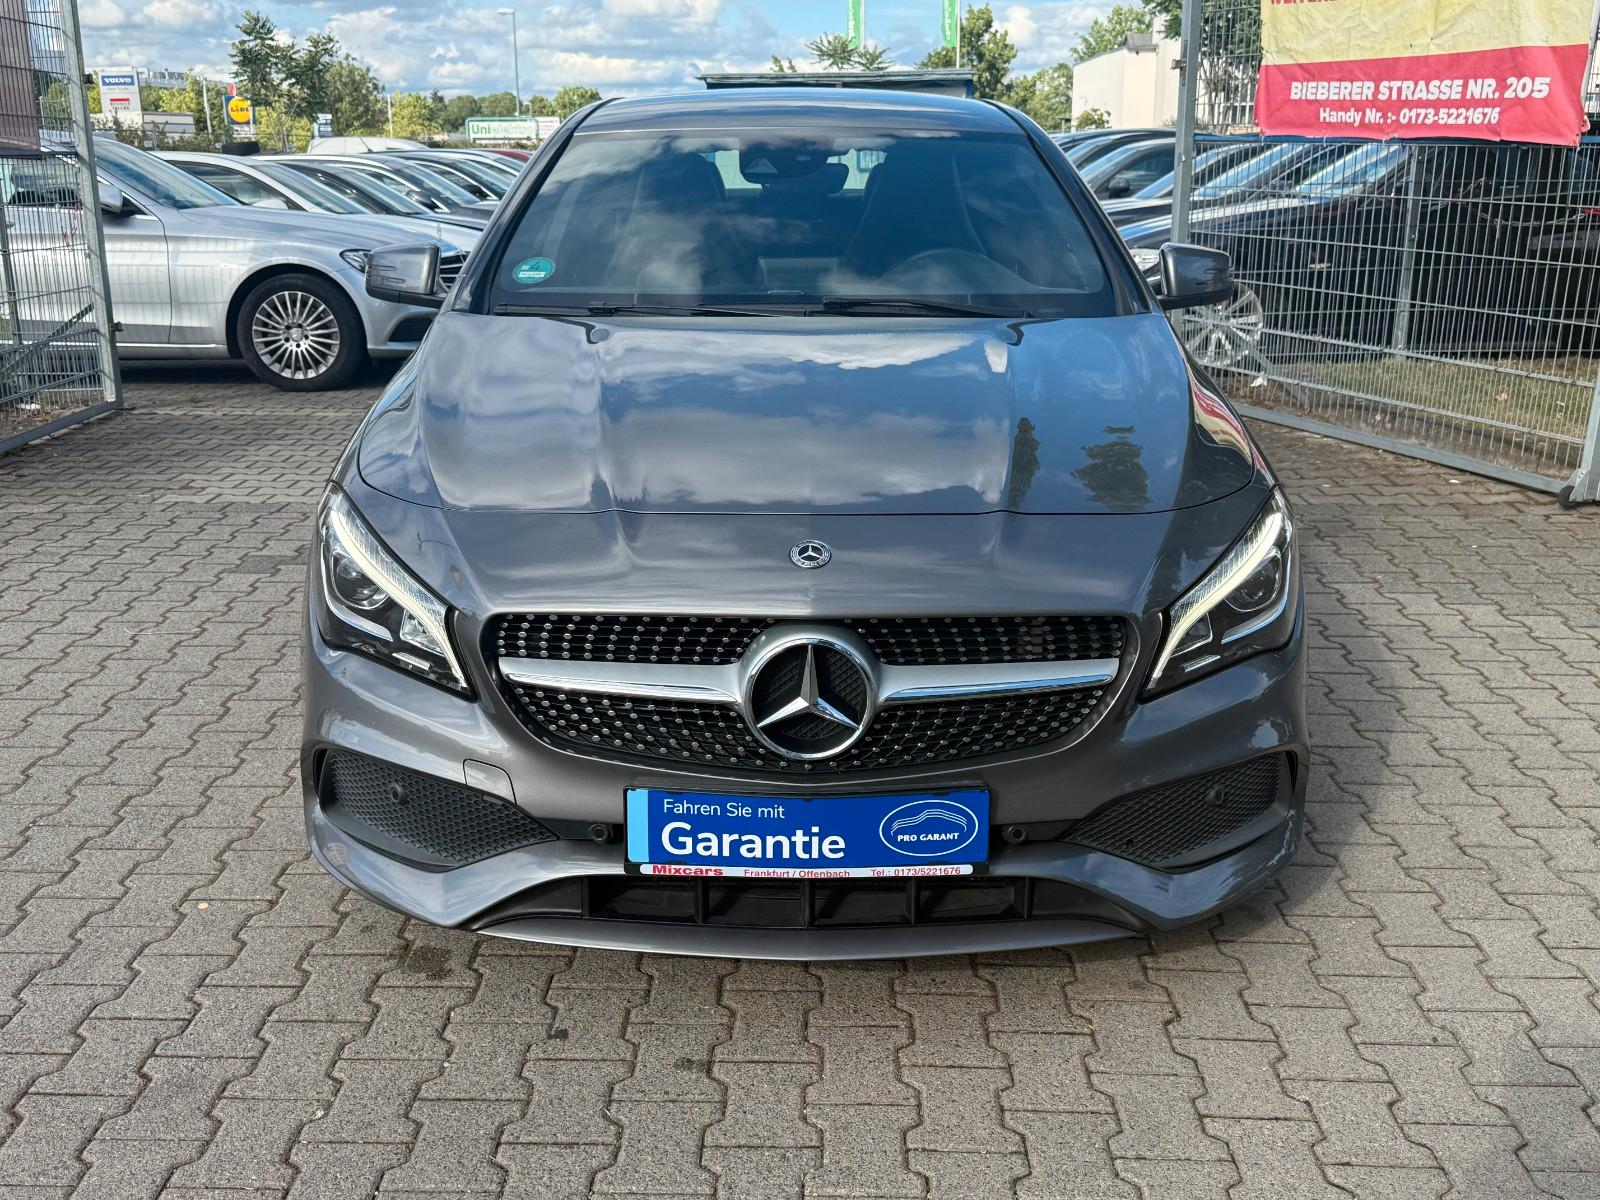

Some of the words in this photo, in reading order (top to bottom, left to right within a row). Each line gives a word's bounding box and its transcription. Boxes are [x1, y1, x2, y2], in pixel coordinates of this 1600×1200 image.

[1290, 81, 1375, 100] BIEBERER
[1377, 79, 1464, 100] STRASSE
[1466, 78, 1500, 99] NR.
[1503, 76, 1552, 99] 205
[1319, 107, 1362, 127] Handy
[1364, 107, 1384, 123] Nr.
[1399, 107, 1501, 124] 0173-5221676
[663, 799, 721, 816] Fahren
[726, 802, 752, 817] Sie
[757, 804, 785, 819] mit
[661, 821, 846, 860] Garantie
[897, 834, 917, 842] PRO
[919, 832, 960, 842] GARANT
[652, 864, 724, 876] Mixcars
[744, 869, 790, 878] Frankfurt
[798, 869, 850, 878] Offenbach
[870, 868, 891, 877] Tel.:
[894, 866, 961, 876] 0173/5221676
